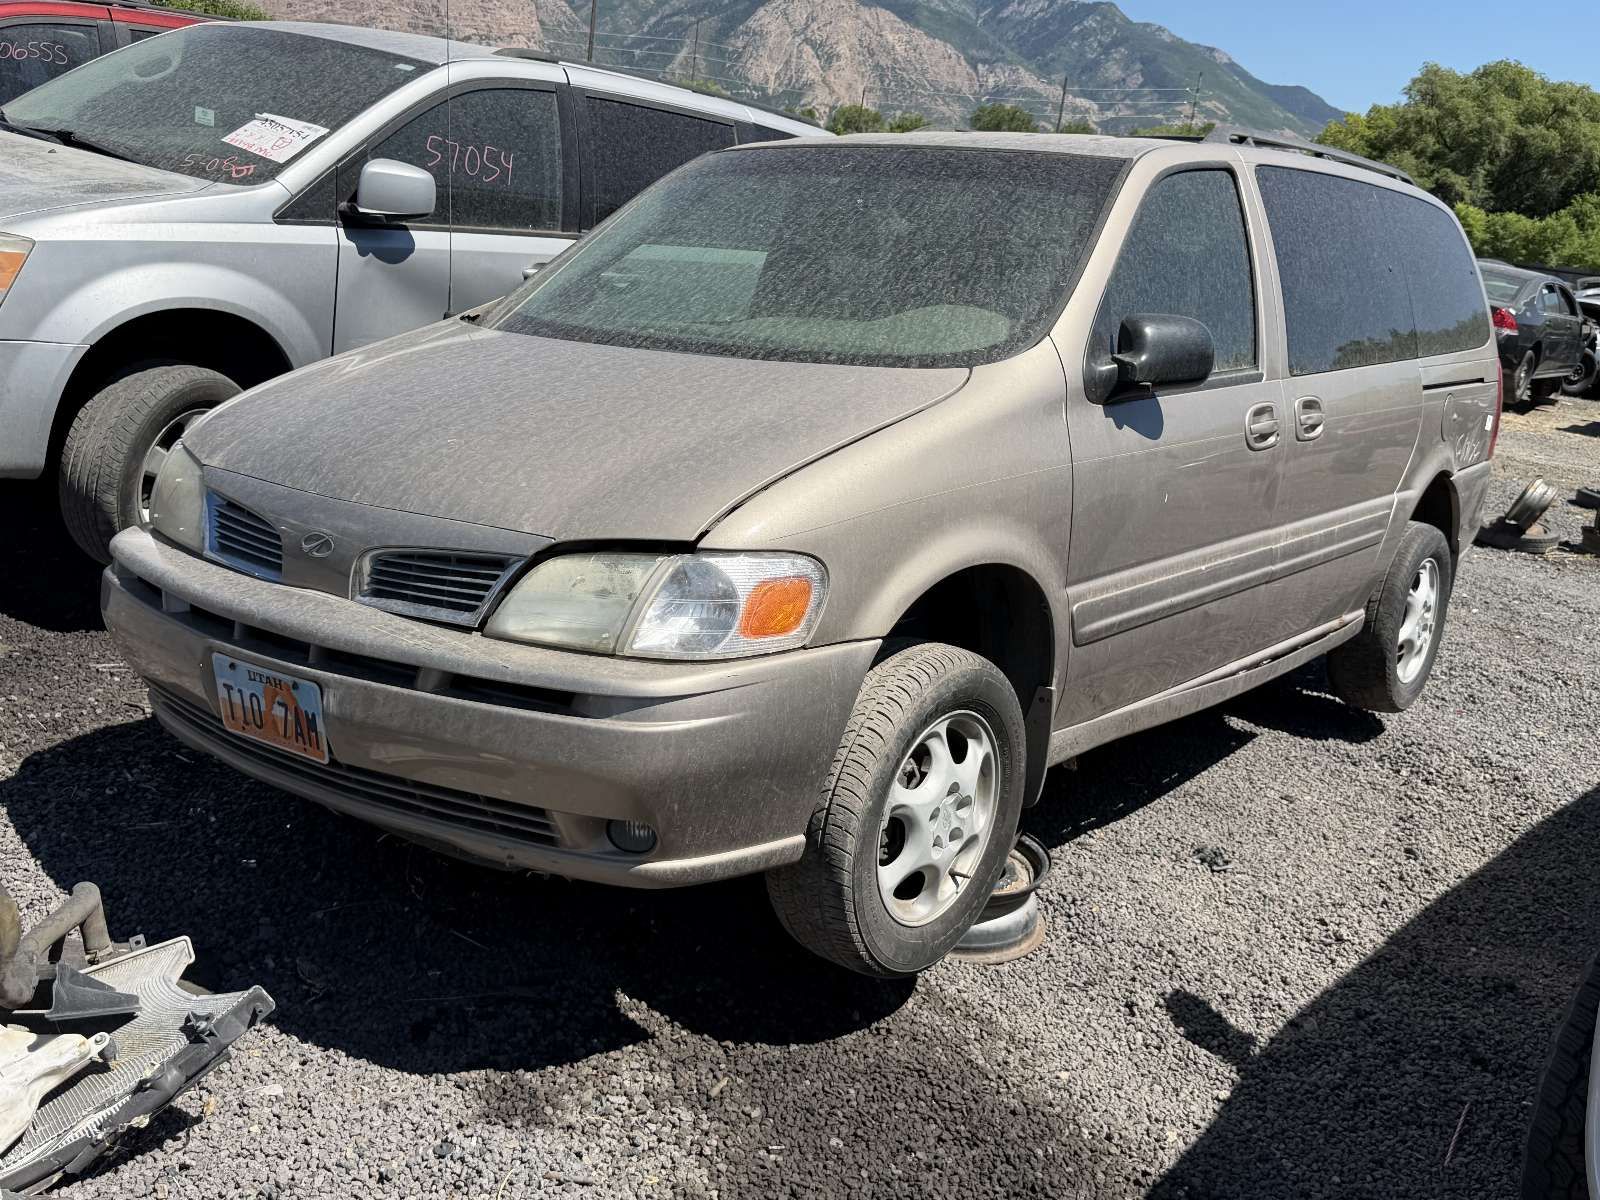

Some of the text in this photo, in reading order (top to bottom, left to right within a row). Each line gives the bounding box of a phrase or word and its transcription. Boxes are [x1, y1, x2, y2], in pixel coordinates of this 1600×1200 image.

[427, 135, 514, 186] 57054
[247, 670, 283, 690] UTAH
[276, 700, 320, 751] 7AM
